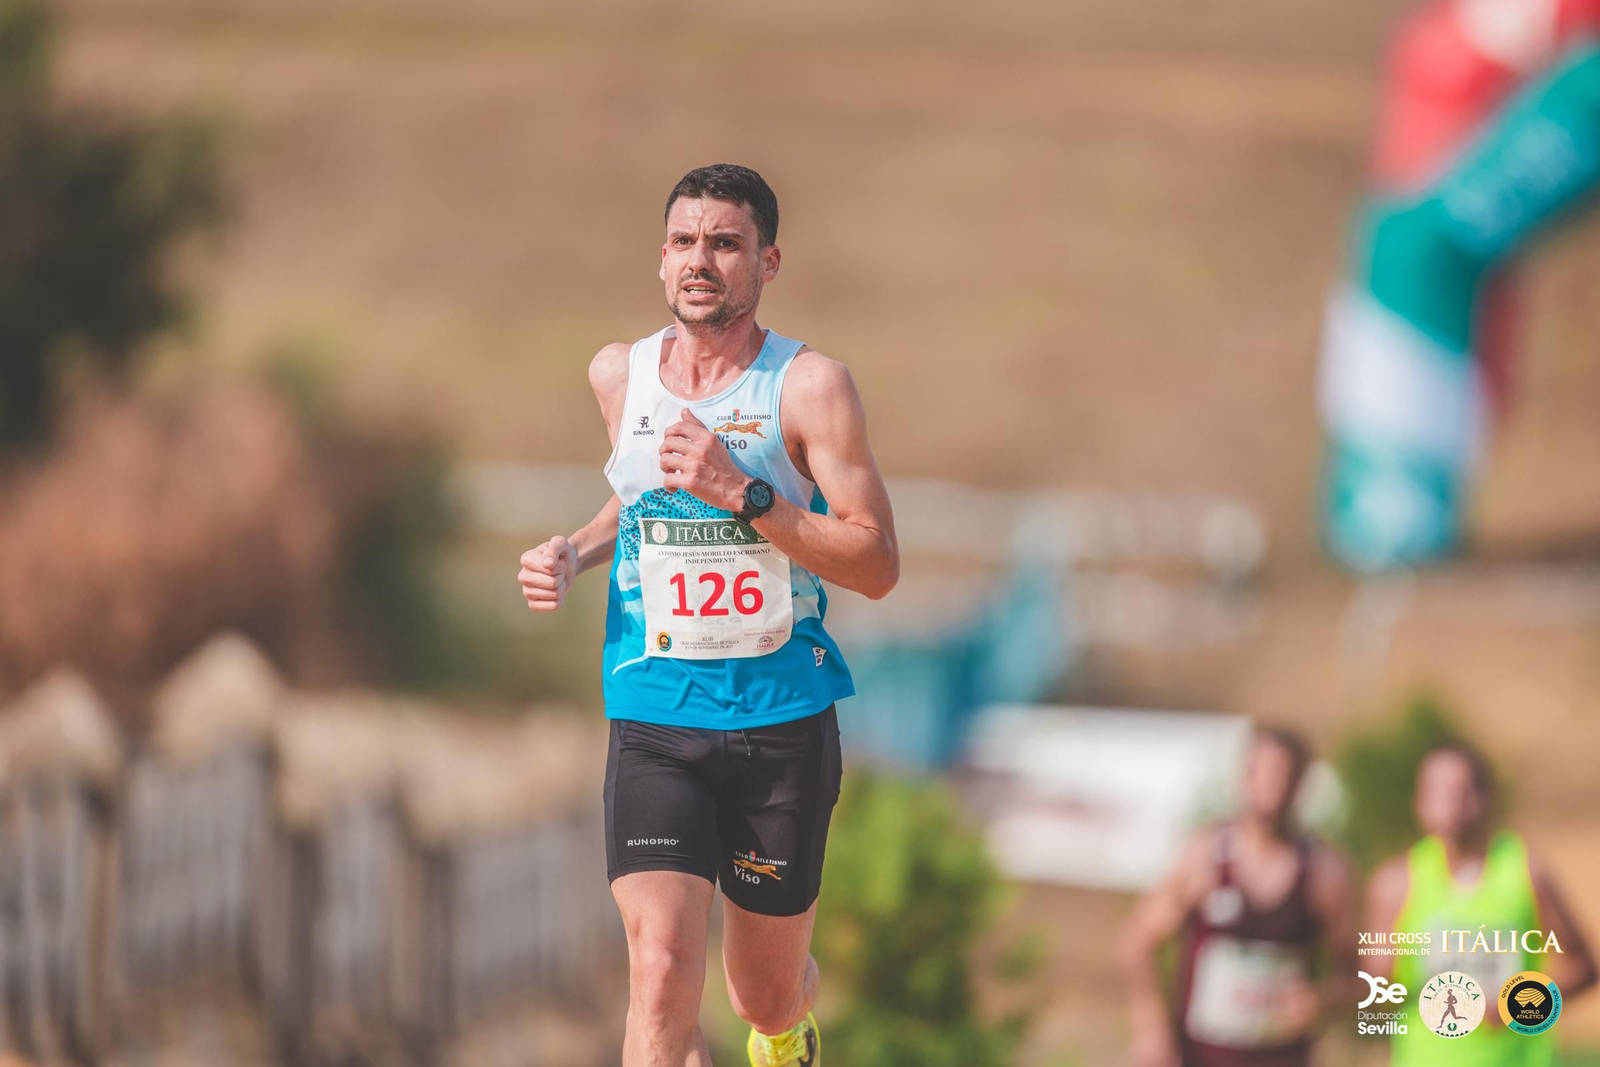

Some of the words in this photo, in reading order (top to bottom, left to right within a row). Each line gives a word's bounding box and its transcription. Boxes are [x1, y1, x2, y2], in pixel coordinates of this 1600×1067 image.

[675, 523, 746, 542] ITÁLICA
[701, 549, 732, 557] MORILLO
[733, 548, 771, 556] ESCRIBANO
[669, 570, 764, 617] 126
[735, 850, 749, 859] CLUB
[756, 857, 787, 867] ATLETISMO
[733, 865, 761, 885] Viso
